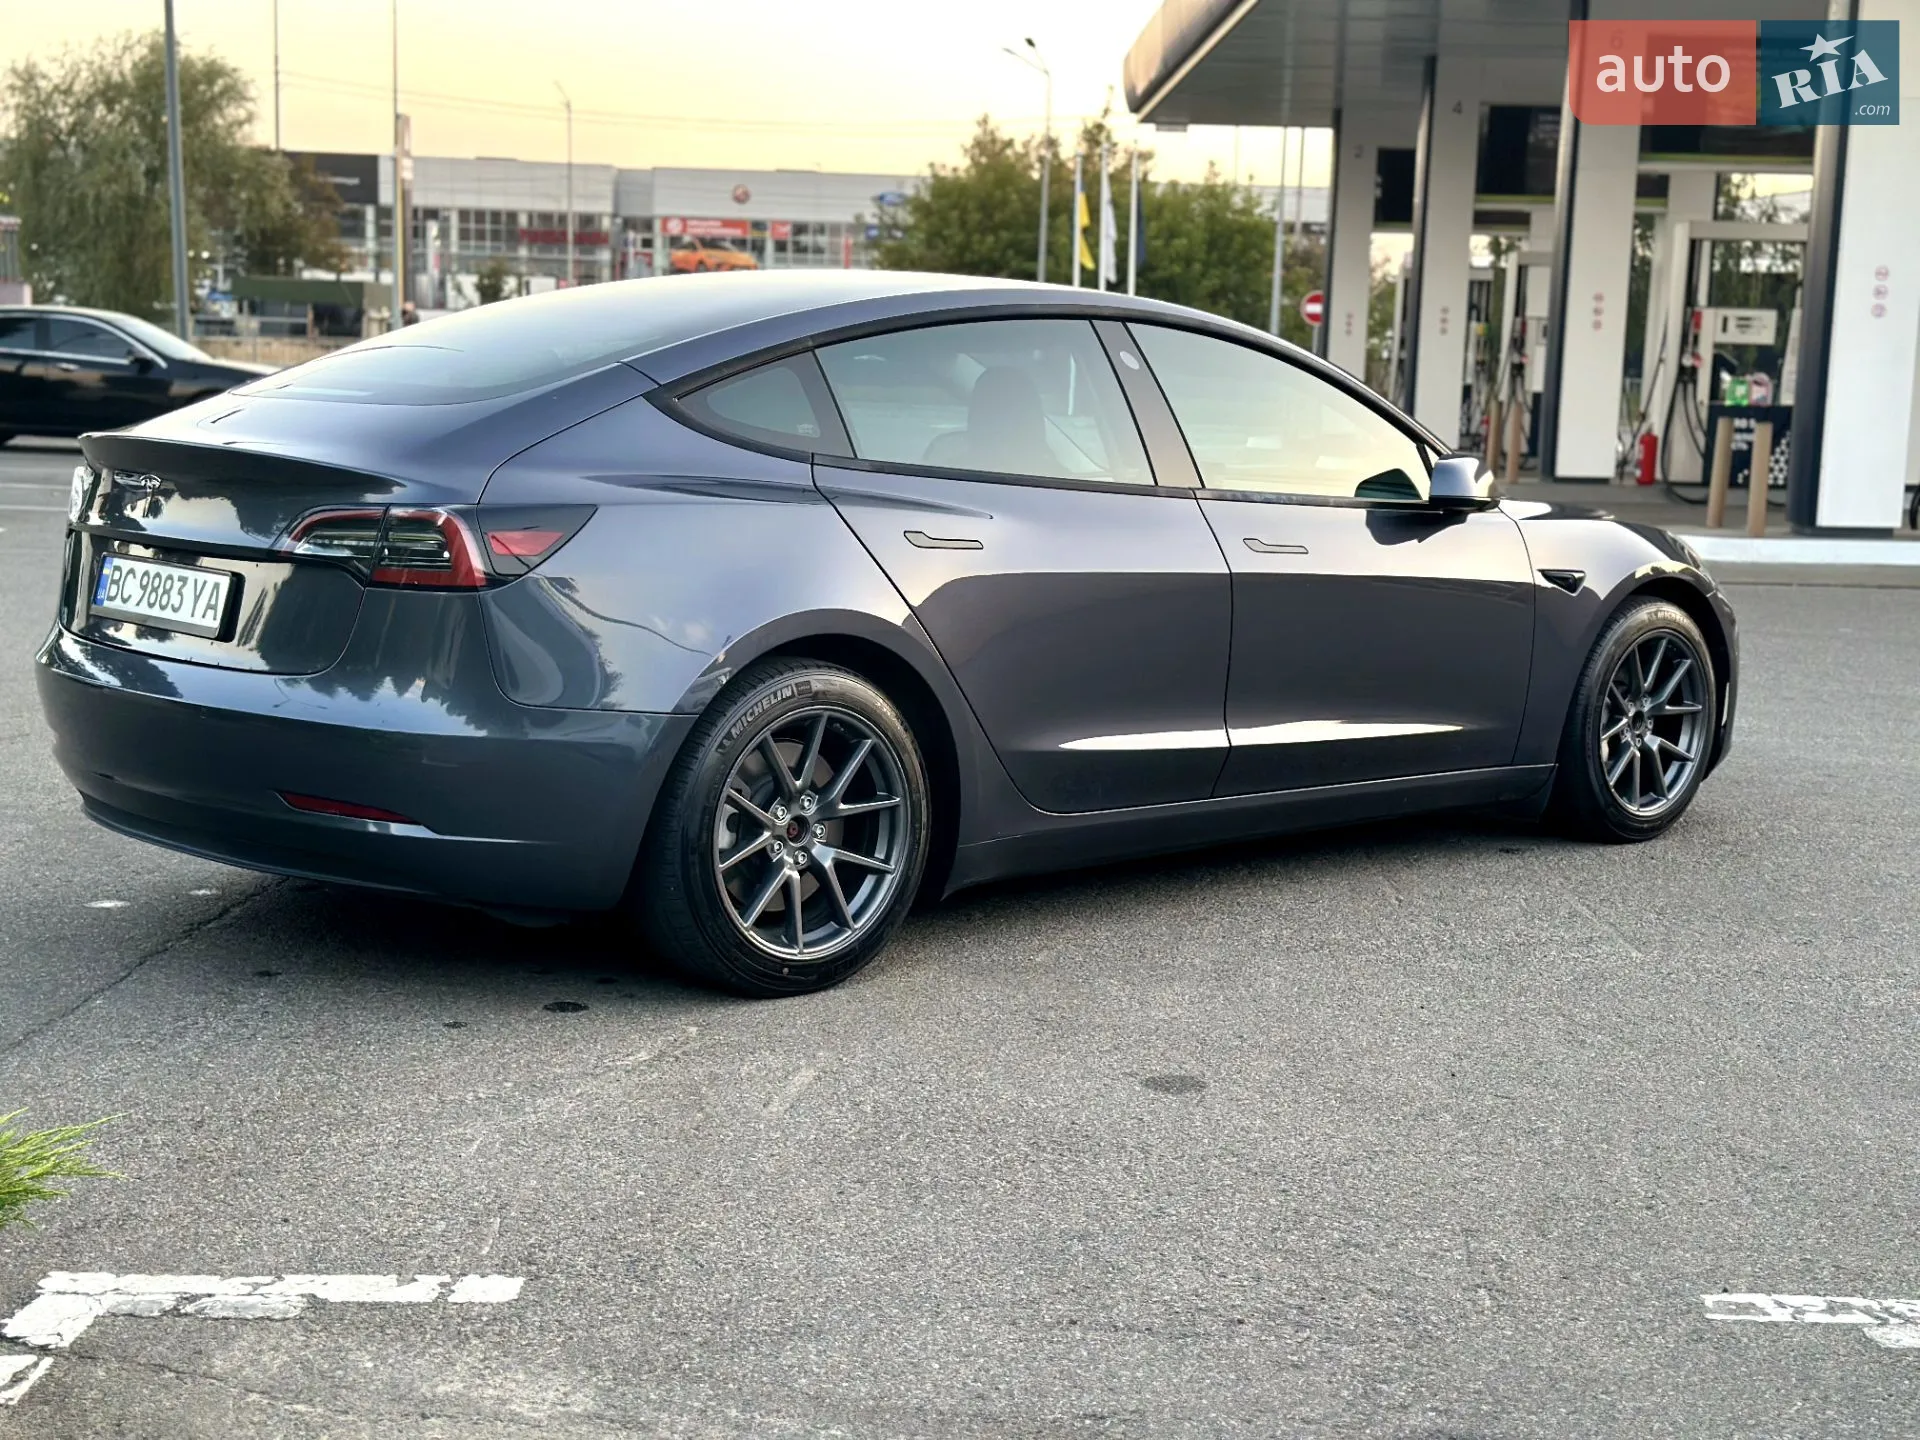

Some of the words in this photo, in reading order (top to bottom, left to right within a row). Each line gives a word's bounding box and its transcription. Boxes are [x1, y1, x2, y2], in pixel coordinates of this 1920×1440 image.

[1452, 100, 1464, 115] 4
[136, 569, 189, 613] 9883
[190, 577, 221, 621] YA
[730, 685, 793, 739] MICHELIN
